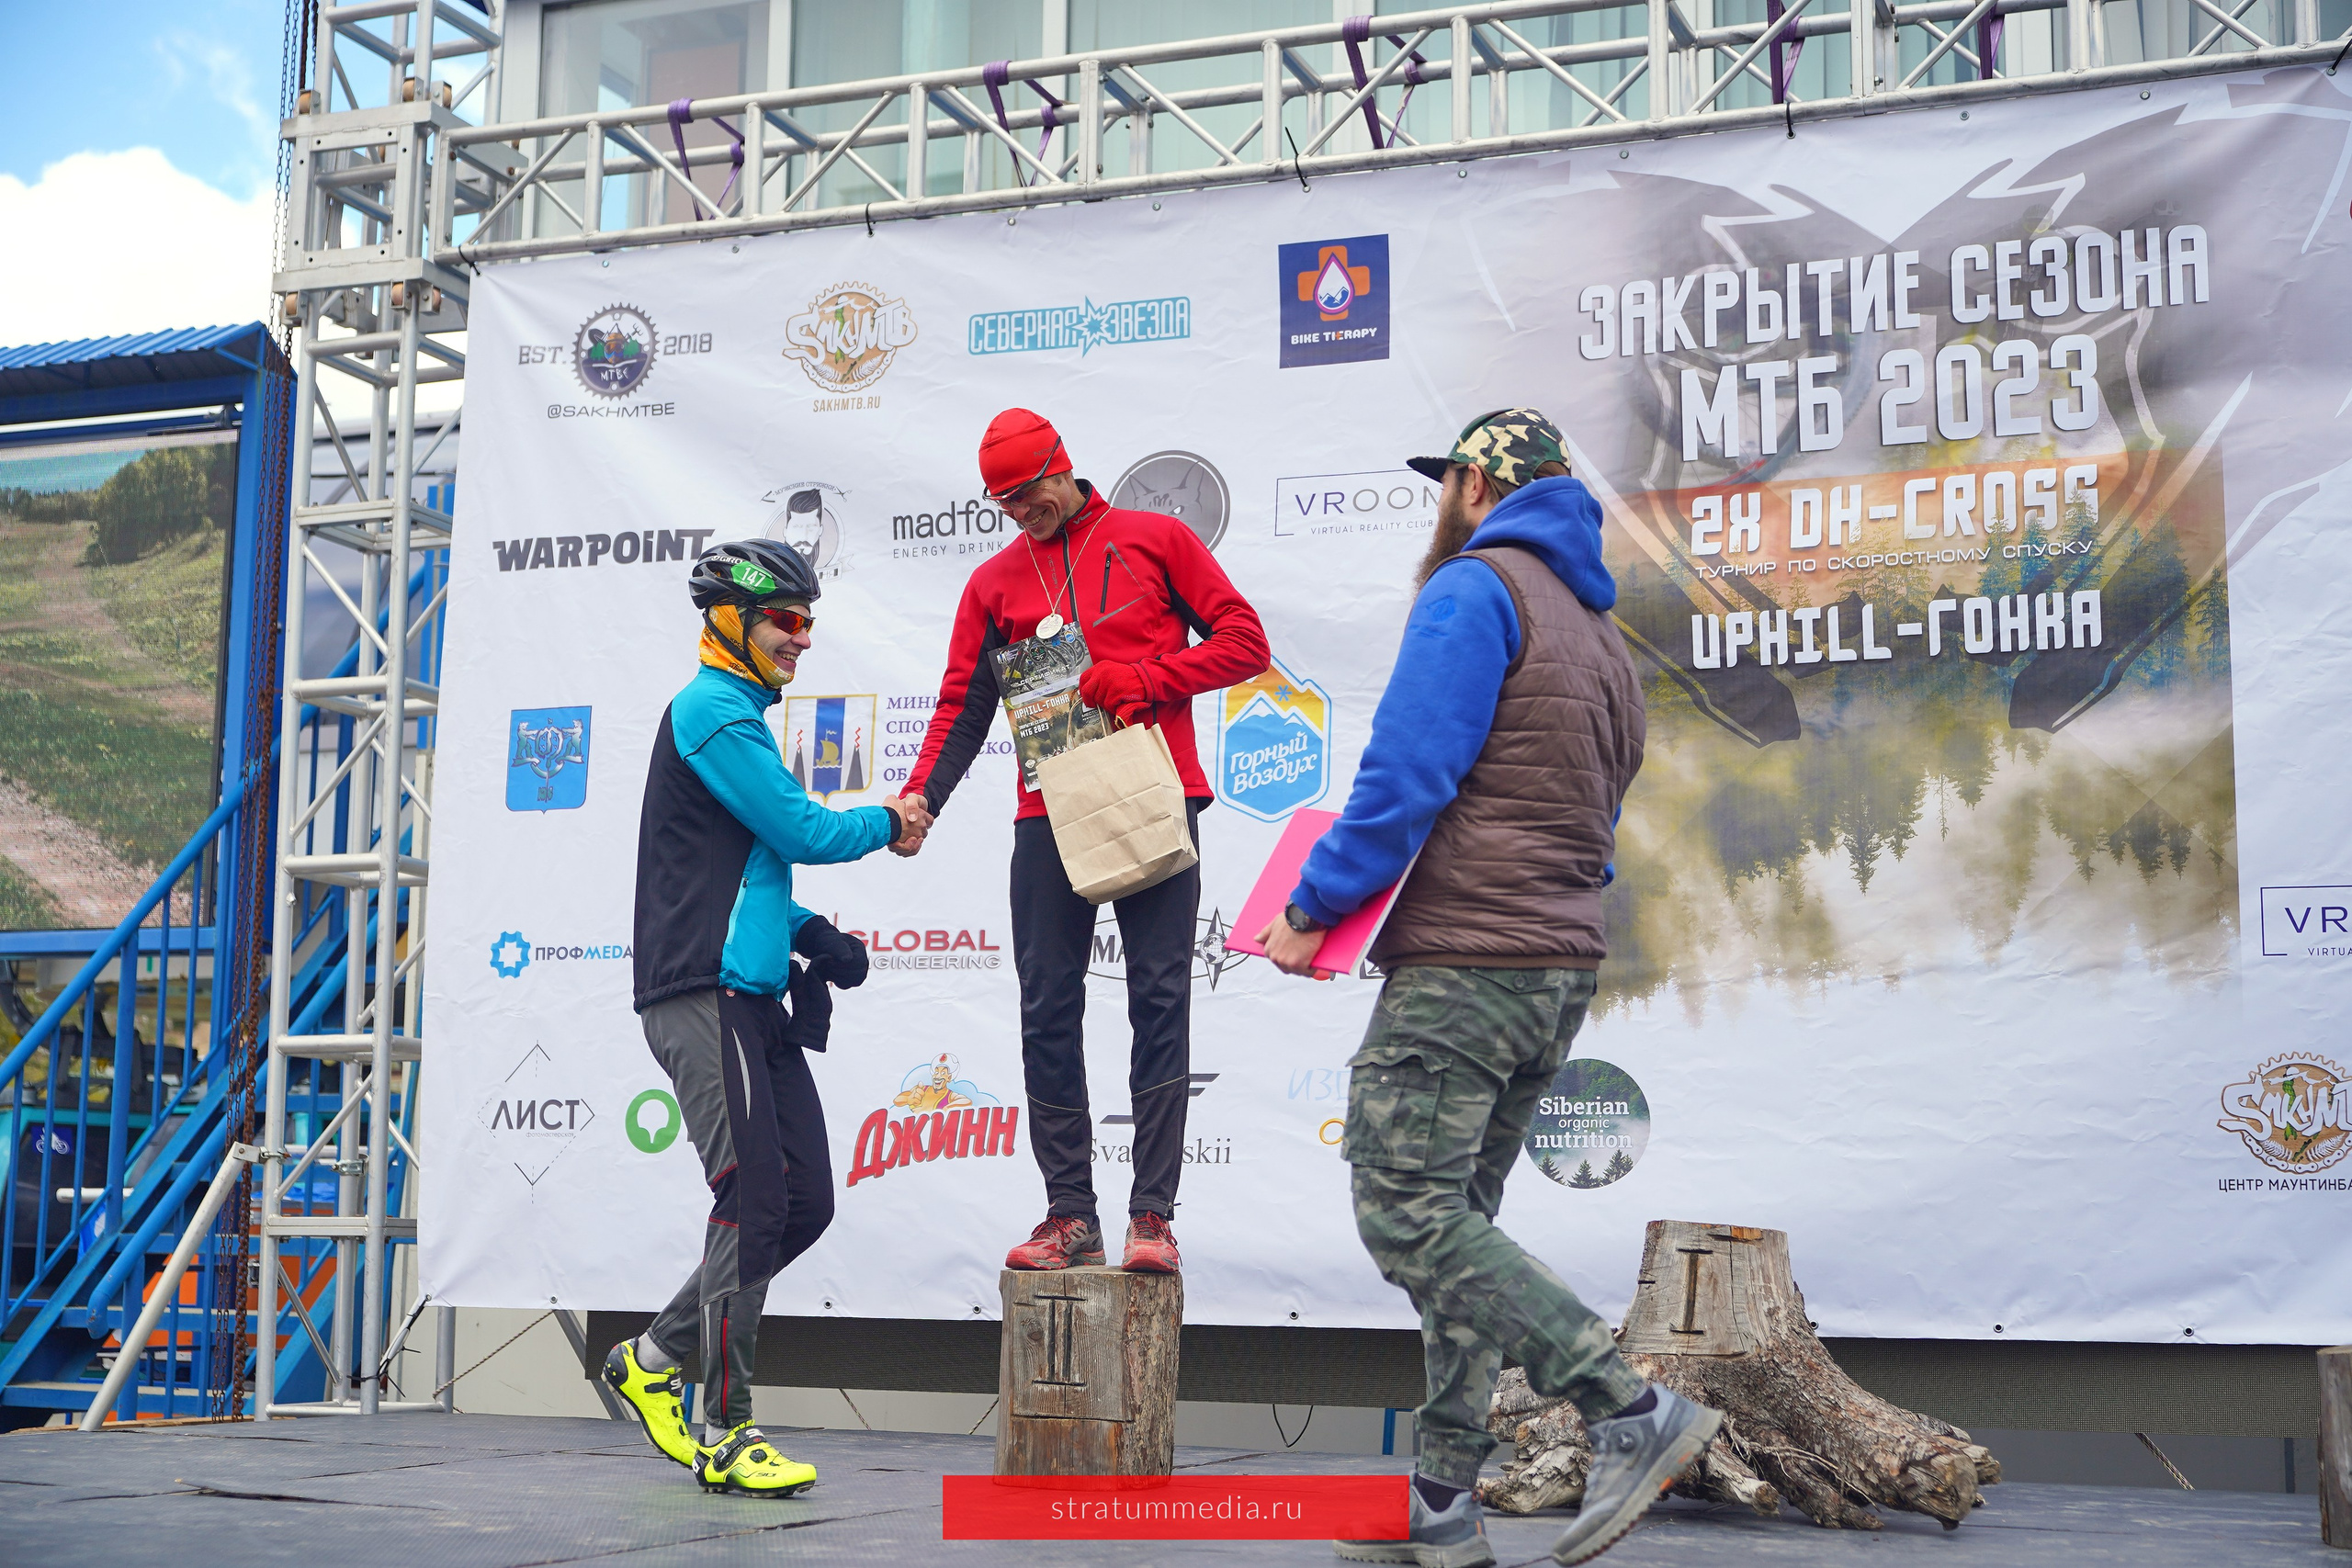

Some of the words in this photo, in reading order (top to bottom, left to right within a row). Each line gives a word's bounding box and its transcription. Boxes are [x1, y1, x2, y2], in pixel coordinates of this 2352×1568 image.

[1579, 250, 1921, 361] ЗАКРЫТИЕ
[1951, 224, 2210, 323] СЕЗОНА
[970, 309, 1078, 354] СЕВЕРНАЯ
[1107, 299, 1188, 343] ЗВЕЗДА
[1291, 333, 1320, 345] BIKE
[518, 345, 567, 366] EST.
[663, 333, 713, 356] 2018
[812, 396, 881, 413] SAKHMTB.RU
[1680, 355, 1845, 462] МТБ
[1879, 333, 2099, 446] 2023
[547, 401, 676, 419] @SAKHMTBE
[1690, 492, 1761, 556] 2X
[1790, 464, 2099, 549] DH-CROSS
[1311, 525, 1354, 536] VIRTUAL
[1360, 522, 1401, 532] REALITY
[1407, 519, 1433, 529] CLUB
[893, 545, 947, 558] ENERGY
[959, 540, 1005, 554] DRINK
[1695, 561, 1777, 580] ТУРНИР
[1788, 558, 1817, 574] ПО
[1827, 547, 1992, 570] СКОРОСТНОМУ
[2002, 540, 2094, 559] СПУСКУ
[741, 567, 766, 587] 147
[1020, 664, 1070, 686] СЕРТИФИКАТ
[1034, 722, 1049, 734] 2023
[2307, 947, 2352, 956] VIRTUA
[868, 955, 1001, 970] GINEERING
[491, 1099, 580, 1131] ЛИСТ
[1539, 1096, 1630, 1115] Siberian
[1558, 1115, 1610, 1132] organic
[1534, 1129, 1633, 1148] nutrition
[2219, 1179, 2264, 1192] ЦЕНТР
